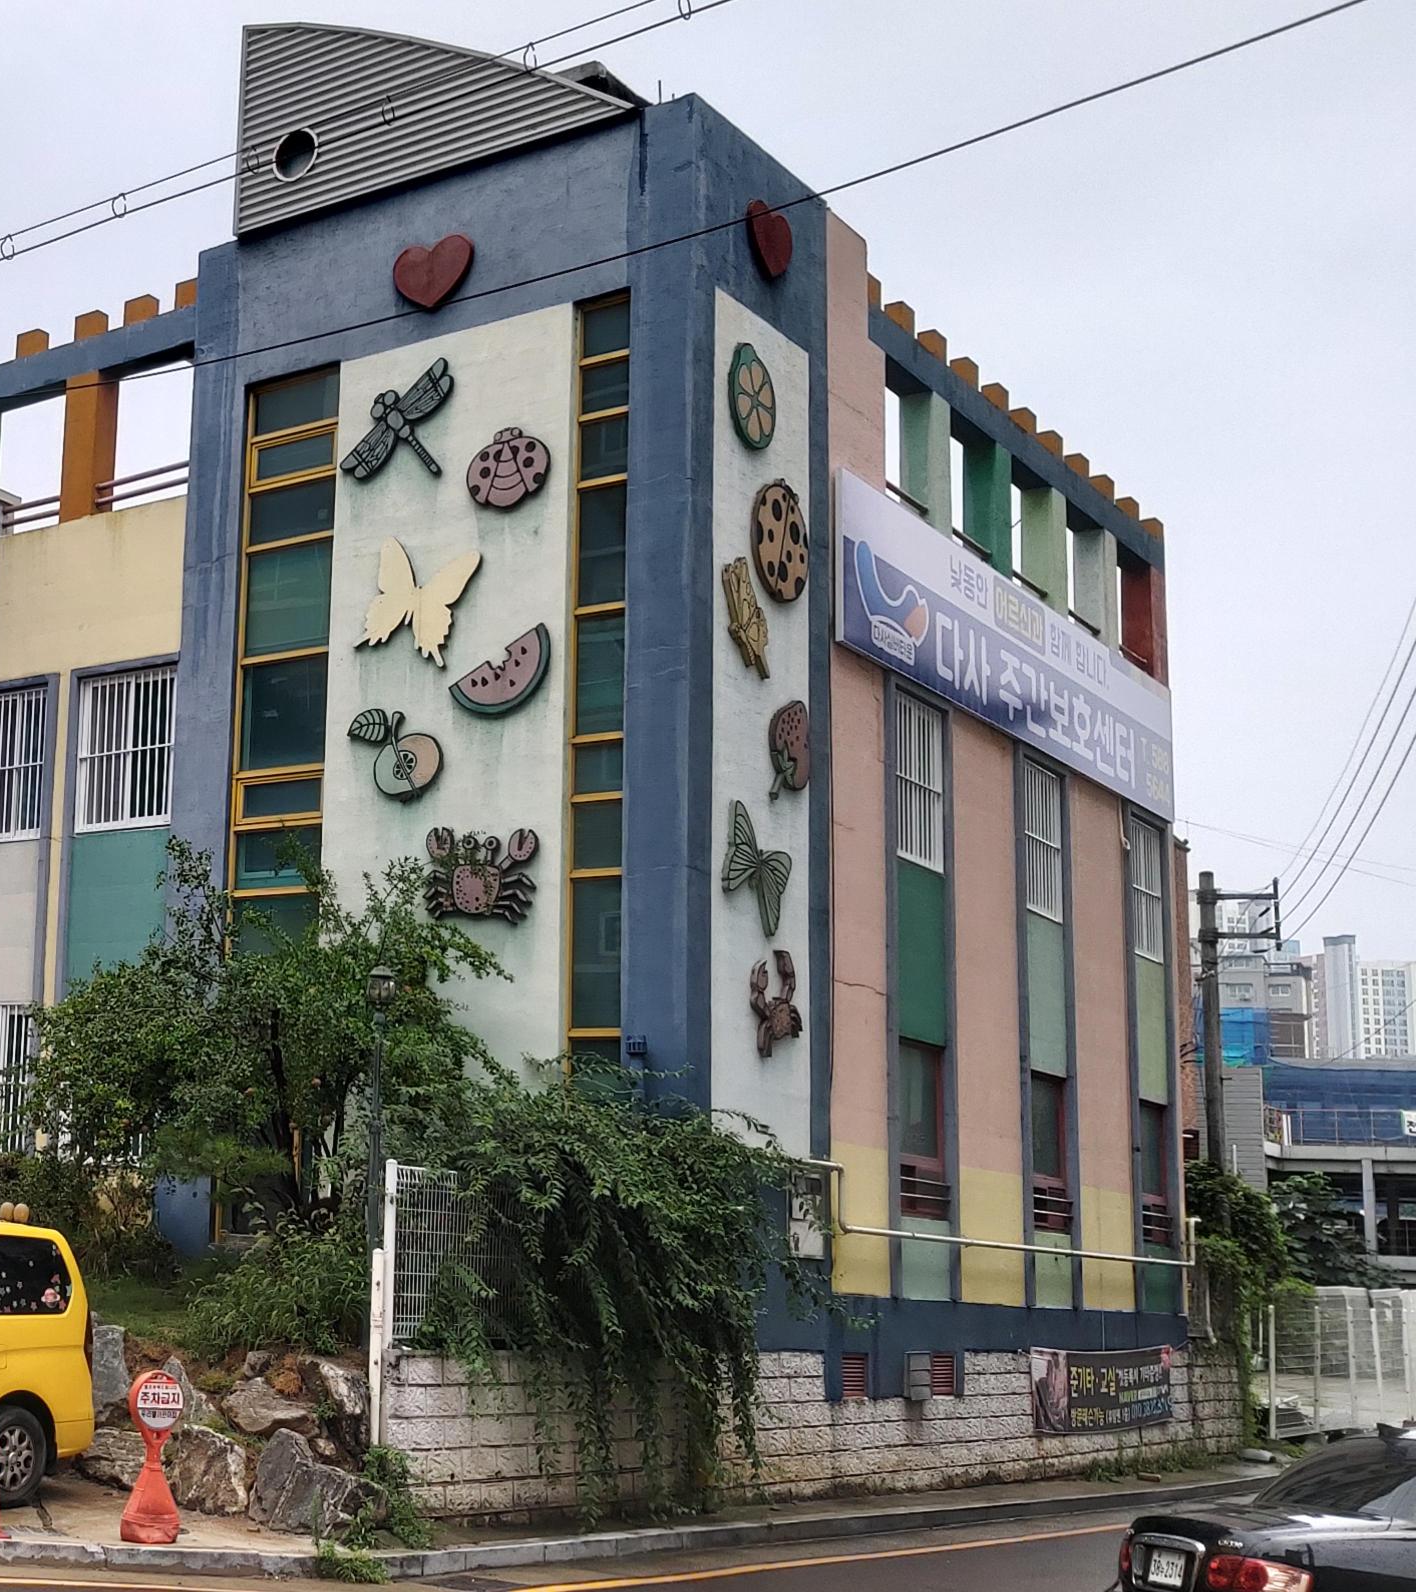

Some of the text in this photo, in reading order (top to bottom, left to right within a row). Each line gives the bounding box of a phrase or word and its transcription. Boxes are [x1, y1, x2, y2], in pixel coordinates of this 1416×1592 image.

[950, 555, 988, 609] 낮동안
[995, 586, 1044, 647] 어르신과
[936, 612, 1136, 789] 다사 주간보호센터
[141, 1391, 180, 1406] 주차금지
